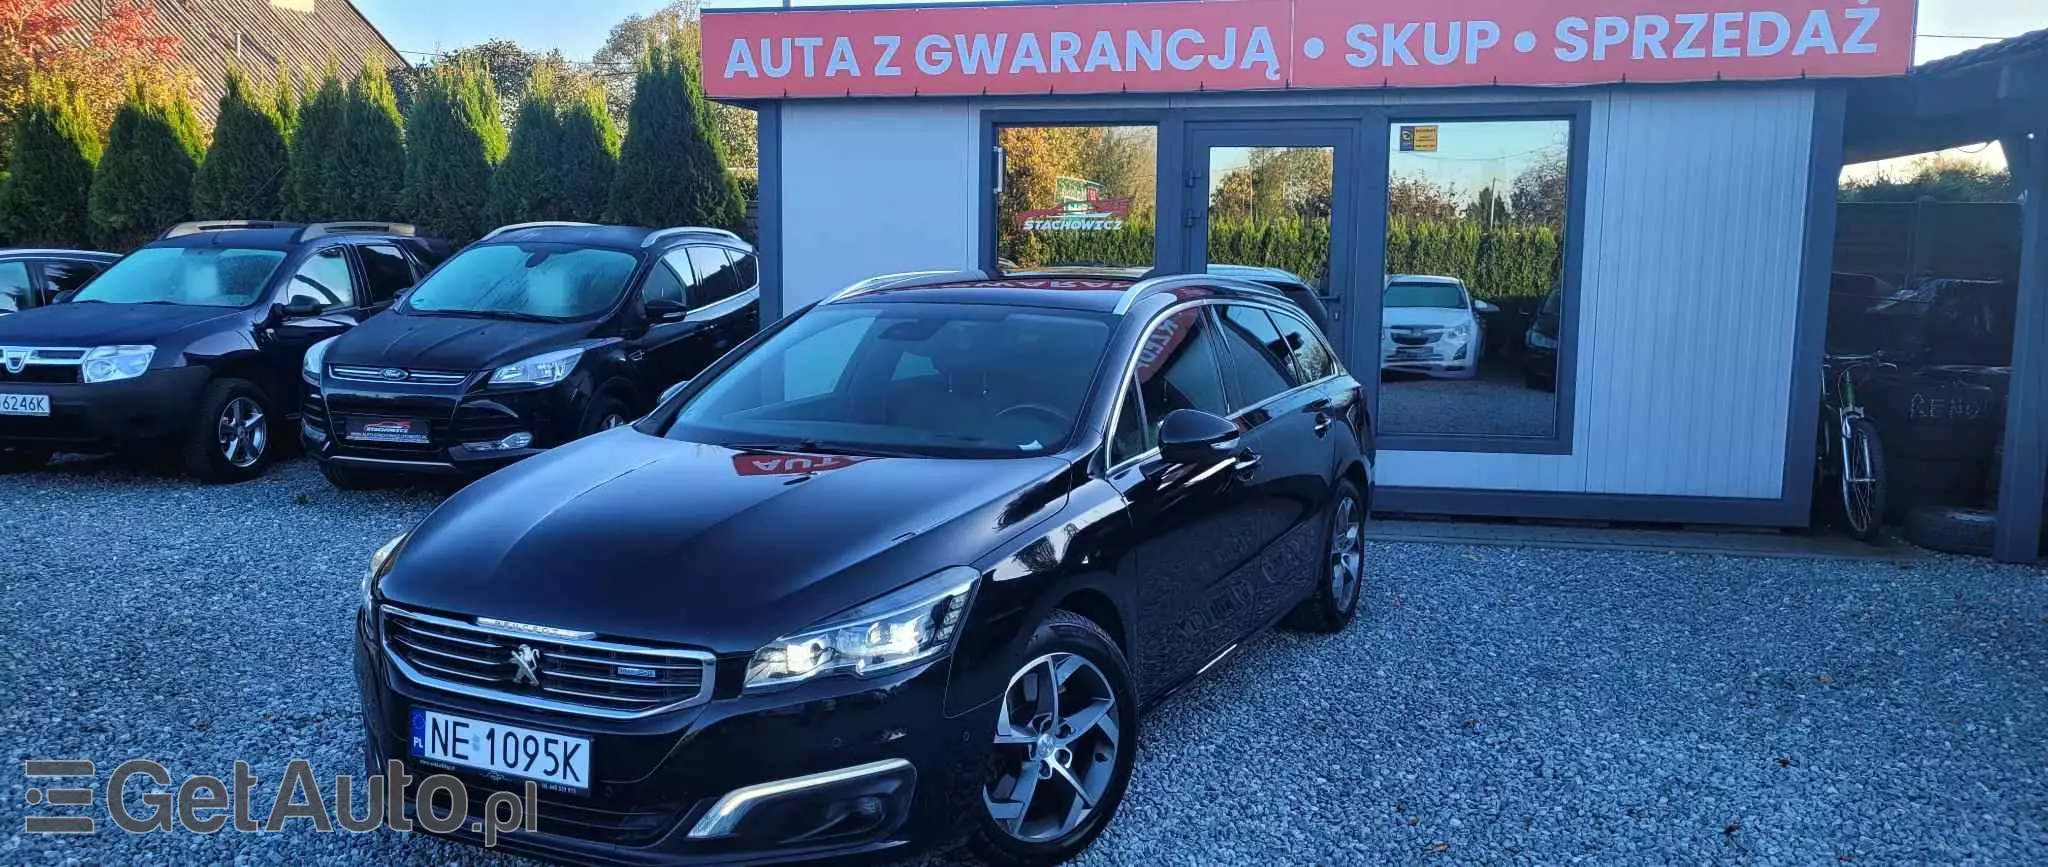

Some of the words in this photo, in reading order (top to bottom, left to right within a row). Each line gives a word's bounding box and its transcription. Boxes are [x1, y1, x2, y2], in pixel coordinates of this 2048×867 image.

[724, 37, 860, 78] AUTA
[874, 36, 901, 76] Z
[915, 26, 1280, 80] GWARANCJĄ
[1345, 20, 1500, 67] SKUP
[1555, 0, 1879, 61] SPRZEDAŻ
[1023, 219, 1122, 231] STACHOWICZ
[2, 396, 46, 412] 6246K
[413, 736, 424, 748] PL
[431, 717, 470, 760] NE
[486, 728, 582, 782] 1095K
